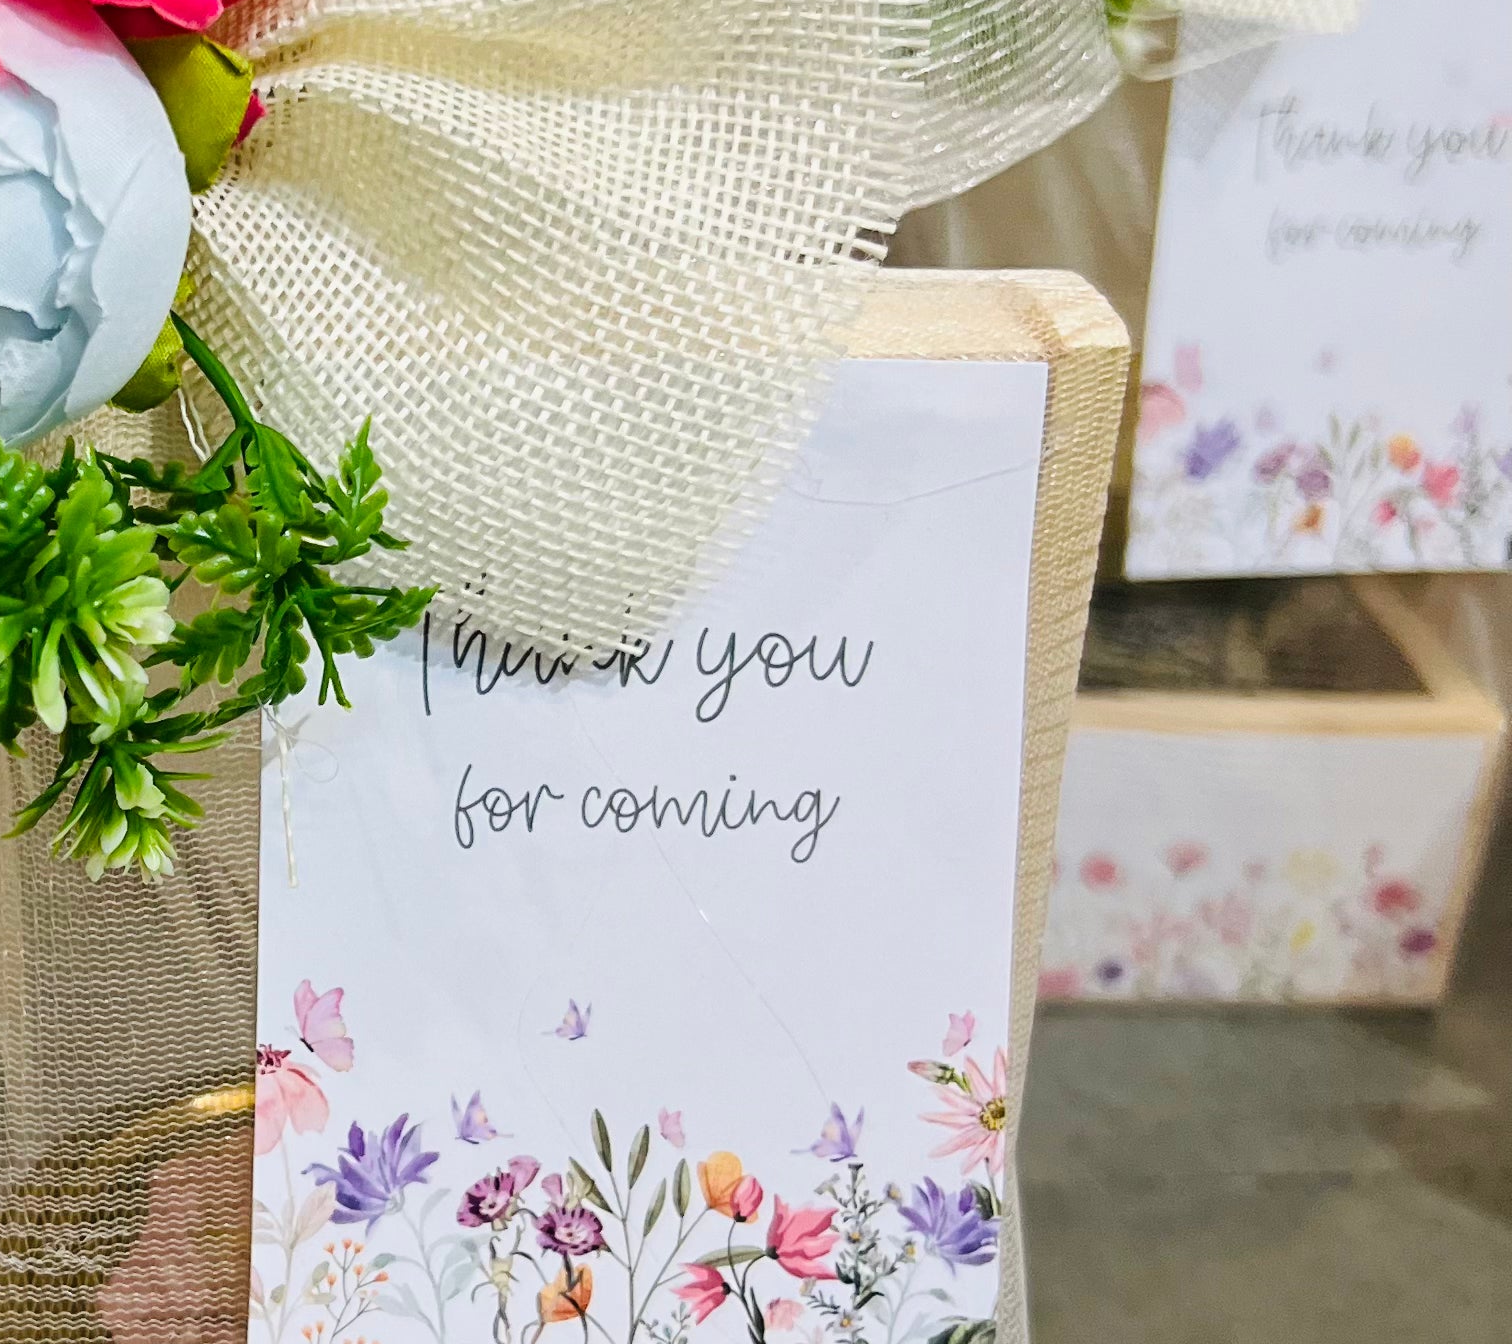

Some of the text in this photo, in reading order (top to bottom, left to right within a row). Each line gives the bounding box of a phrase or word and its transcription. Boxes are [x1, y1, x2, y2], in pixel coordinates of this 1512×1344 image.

[1403, 120, 1510, 187] you
[695, 626, 875, 724] you
[454, 763, 842, 864] for coming
